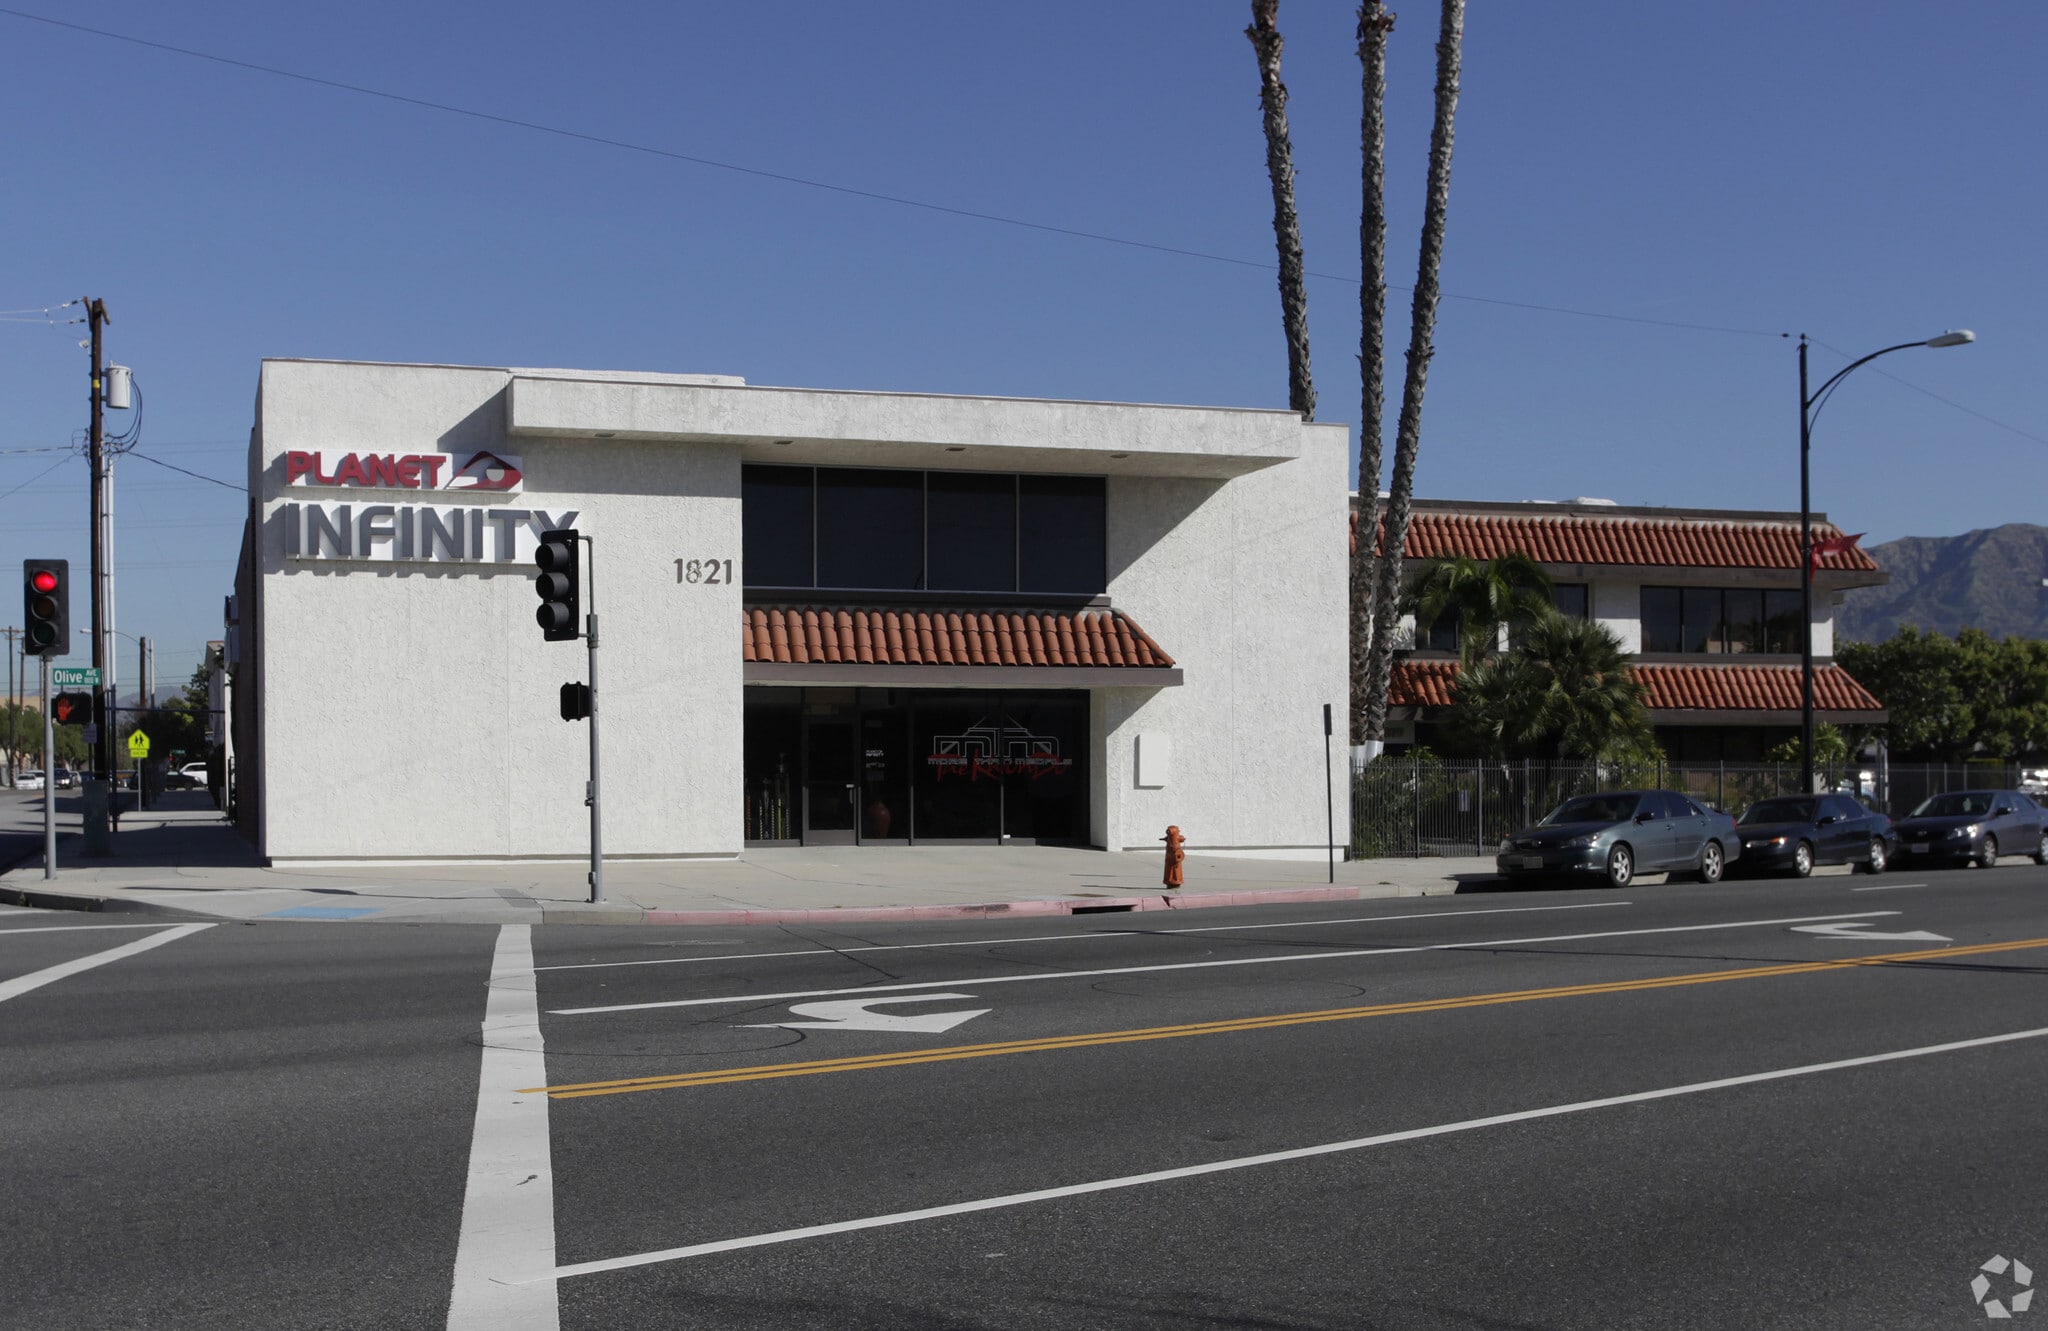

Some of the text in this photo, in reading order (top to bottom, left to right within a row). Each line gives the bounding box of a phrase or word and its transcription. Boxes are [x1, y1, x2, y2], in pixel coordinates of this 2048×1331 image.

[287, 450, 447, 488] PLANET
[673, 558, 732, 585] 1821
[54, 670, 83, 684] Olive
